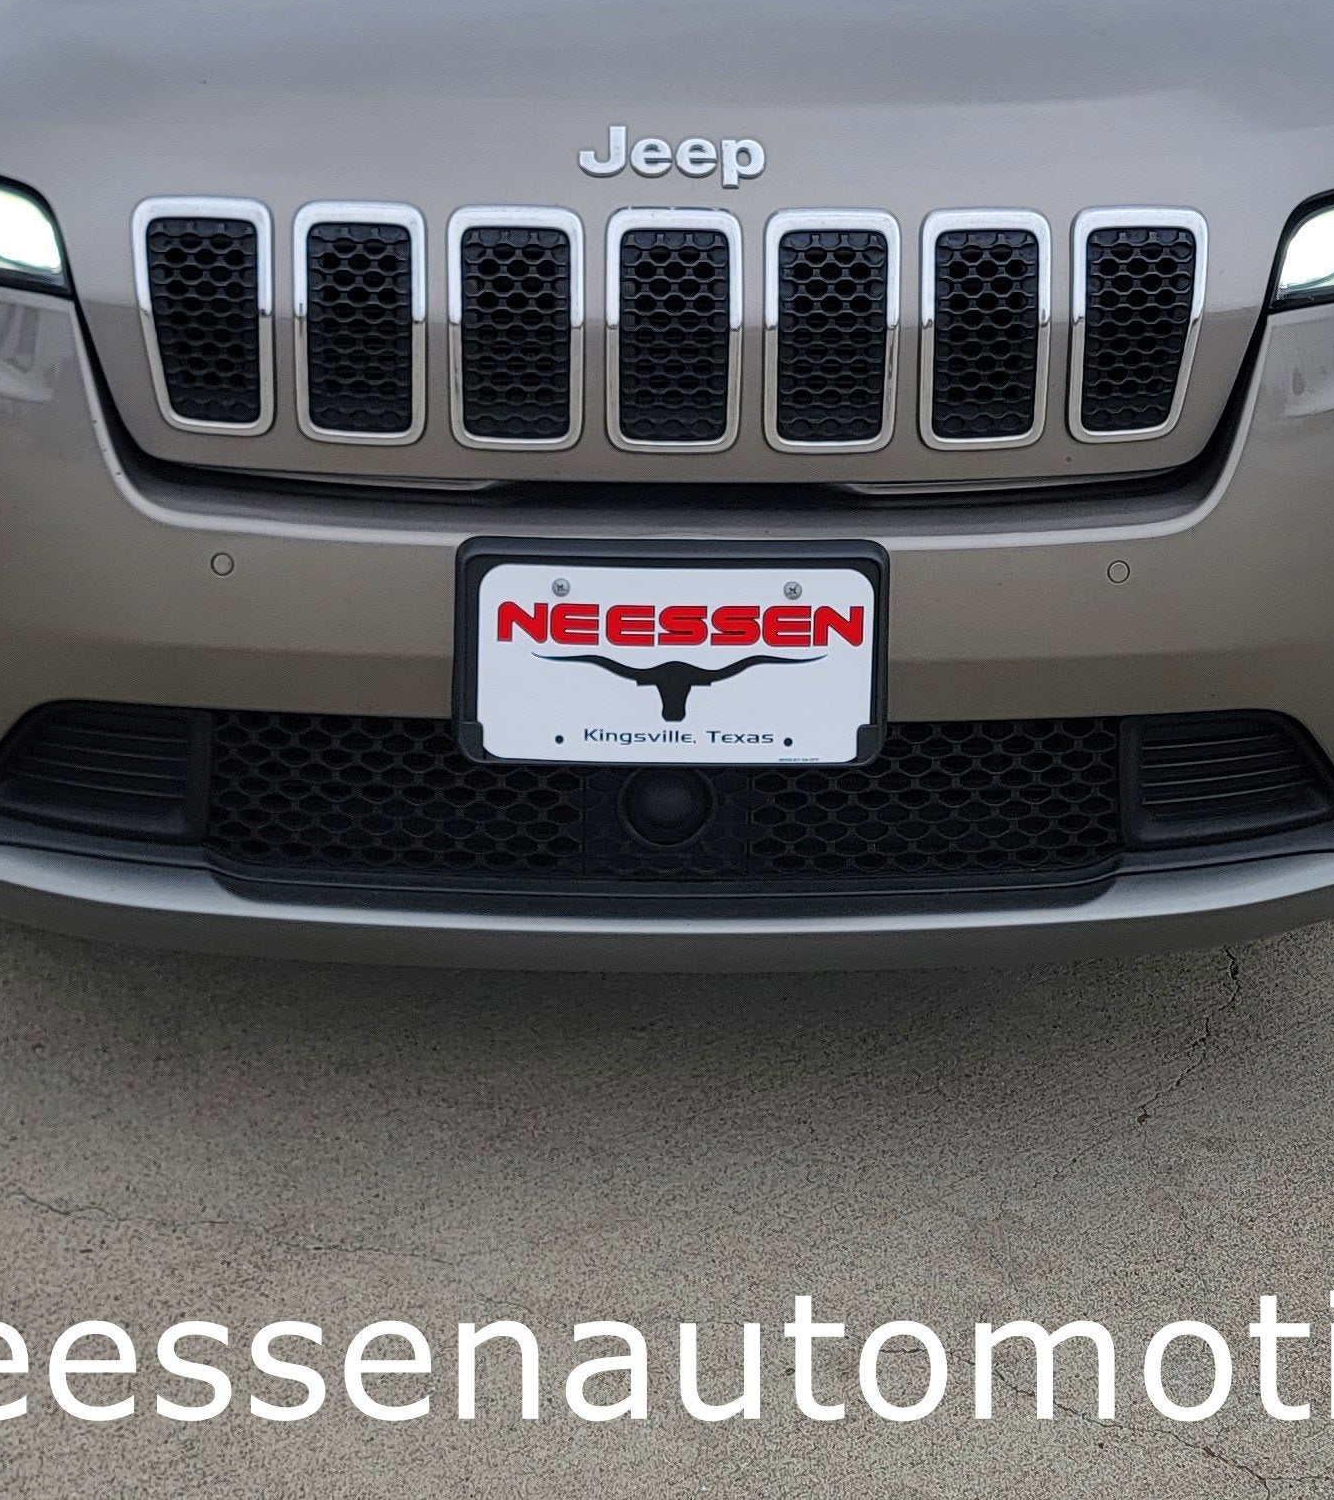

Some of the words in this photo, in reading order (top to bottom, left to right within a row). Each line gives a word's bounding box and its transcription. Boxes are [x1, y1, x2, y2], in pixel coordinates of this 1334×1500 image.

[578, 124, 766, 189] Jeep
[496, 601, 865, 648] NEESSEN
[583, 728, 698, 746] Kingsville,
[705, 730, 775, 745] Texas
